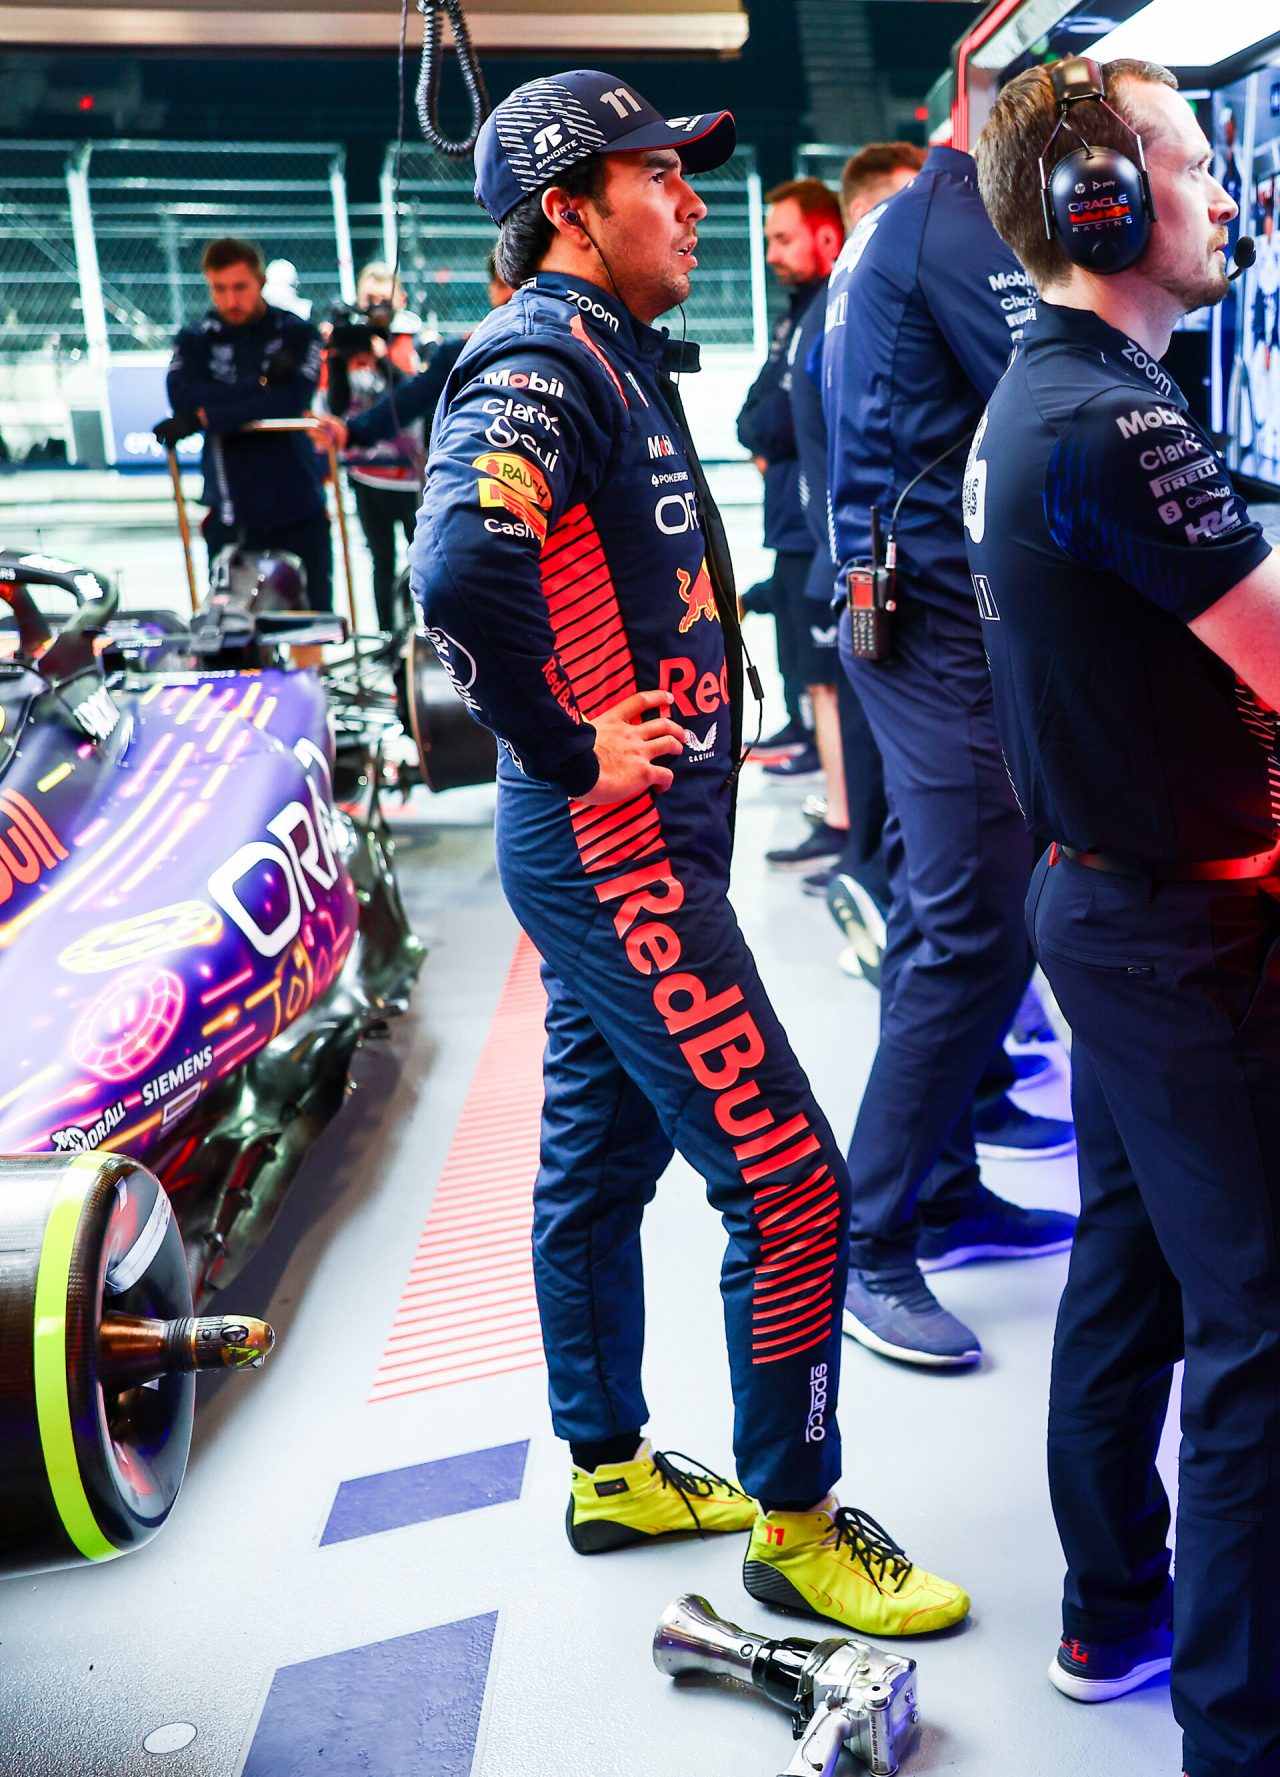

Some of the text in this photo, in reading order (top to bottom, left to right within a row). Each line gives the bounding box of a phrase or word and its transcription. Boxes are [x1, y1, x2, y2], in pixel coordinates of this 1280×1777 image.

[600, 87, 643, 120] 11
[535, 139, 579, 170] BANORTE
[1068, 193, 1129, 213] ORACLE
[1072, 216, 1133, 233] RACING
[565, 289, 620, 333] zoom
[484, 368, 564, 398] Mobil
[1121, 340, 1171, 397] zoom
[482, 398, 556, 434] Claro
[1116, 406, 1188, 440] Mobil
[1139, 436, 1200, 471] Claro
[502, 463, 548, 504] RAUCH
[1149, 455, 1219, 498] PIRELLI
[142, 1044, 213, 1107] SIEMENS
[807, 1362, 828, 1443] sparco
[765, 1524, 785, 1547] 11
